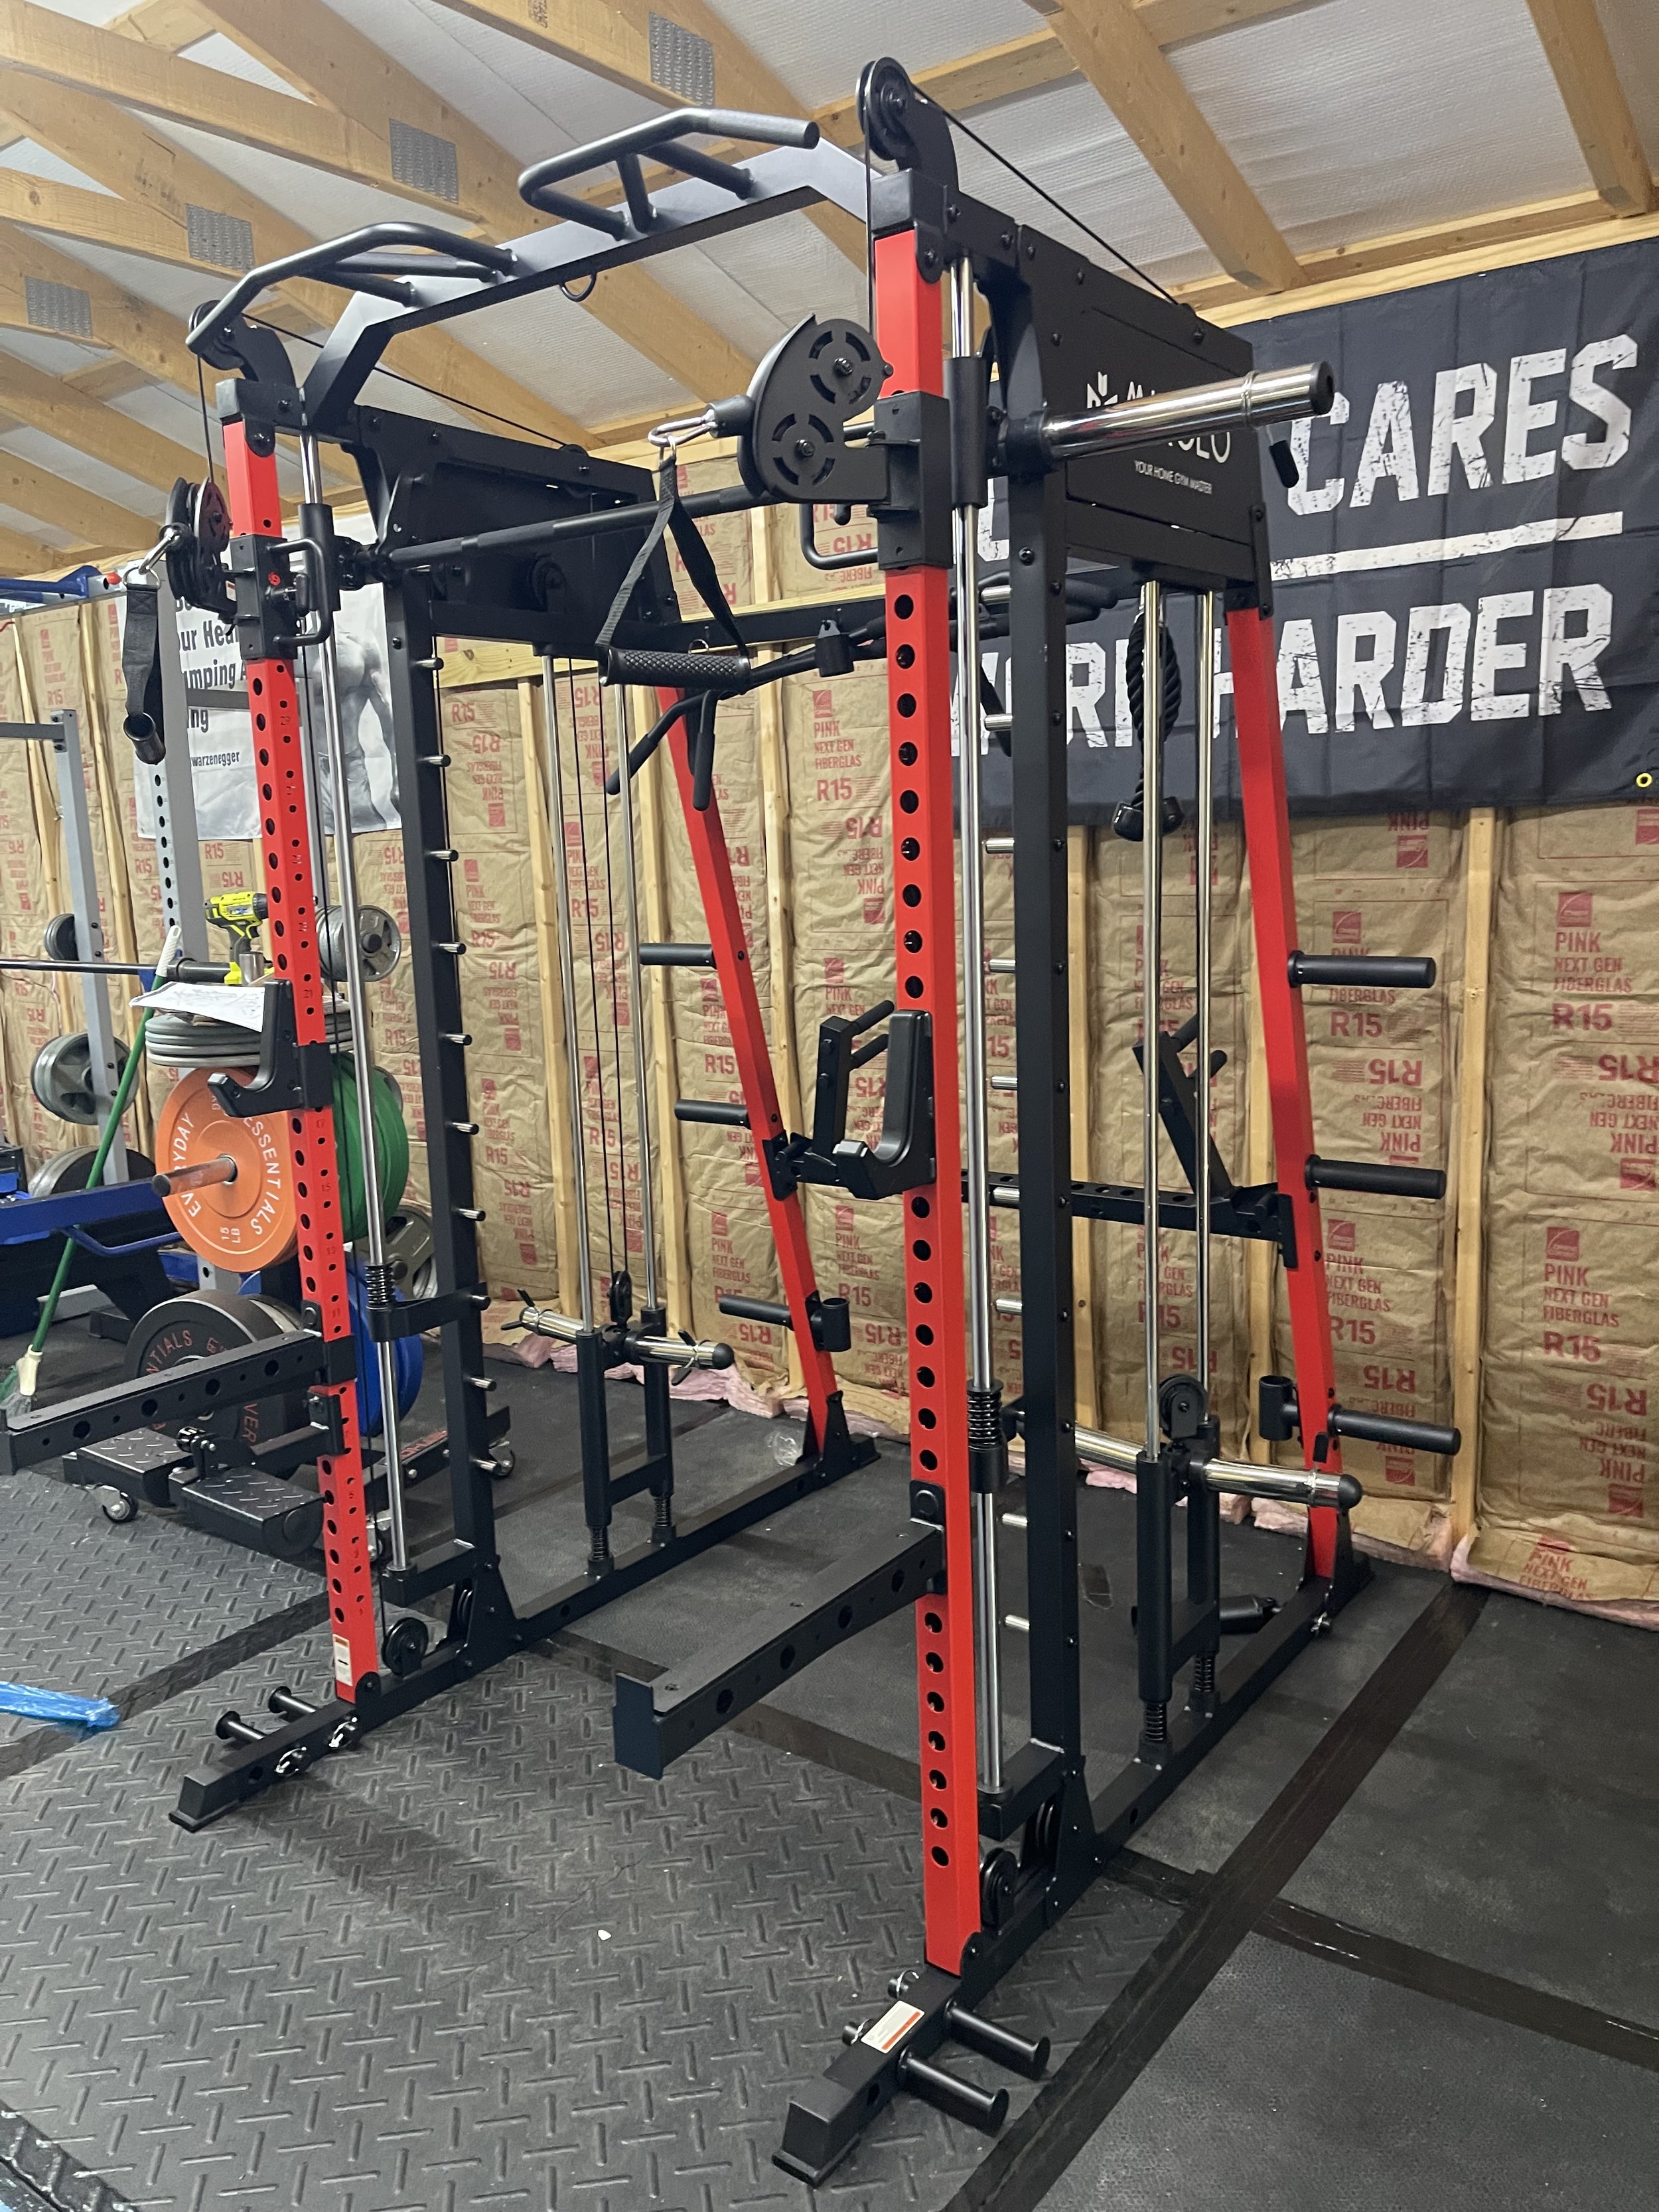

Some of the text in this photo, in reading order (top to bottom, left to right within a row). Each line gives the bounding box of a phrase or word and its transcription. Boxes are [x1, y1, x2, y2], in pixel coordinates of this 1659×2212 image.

[1287, 334, 1638, 516] CARES
[814, 721, 840, 738] PINK
[472, 733, 500, 754] R15
[814, 738, 855, 755] NEXT GEN
[815, 754, 862, 770] FIBERGLAS
[817, 777, 853, 802] R15
[845, 815, 883, 840] R15
[205, 842, 225, 859] R15
[222, 871, 244, 889] R15
[857, 879, 885, 895] PINK
[1555, 931, 1601, 953] PINK
[489, 961, 516, 981] R15
[1554, 956, 1624, 973] NEXT GEN
[826, 987, 852, 1001] PINK
[1553, 976, 1633, 993] FIBERGLAS
[1331, 1011, 1383, 1038] R15
[1551, 1003, 1613, 1031] R15
[705, 1053, 735, 1074] R15
[1369, 1059, 1422, 1086] R15
[1598, 1054, 1659, 1084] R15
[1362, 1112, 1421, 1130] NEXT GEN
[1590, 1112, 1658, 1130] NEXT GEN
[589, 1126, 616, 1147] R5
[1380, 1131, 1421, 1152] PINK
[1610, 1132, 1658, 1155] PINK
[172, 1112, 202, 1218] EVYDAY
[485, 1145, 508, 1165] R15
[609, 1161, 639, 1183] R5
[230, 1228, 242, 1244] LB
[711, 1237, 734, 1255] PINK
[835, 1233, 860, 1250] PINK
[1164, 1266, 1185, 1280] GEN
[1544, 1263, 1589, 1286] PINK
[838, 1283, 872, 1307] R15
[1358, 1278, 1381, 1294] GEN
[1544, 1286, 1612, 1309] NEXT GEN
[1543, 1305, 1620, 1327] FIBERGLAS
[739, 1323, 772, 1345] R15
[865, 1323, 902, 1347] R15
[1330, 1315, 1376, 1345] R15
[1544, 1330, 1602, 1363] R15
[1363, 1364, 1416, 1394] R15
[1587, 1383, 1648, 1416] R15
[1599, 1459, 1646, 1484] PINK
[1528, 1548, 1574, 1572] PINK
